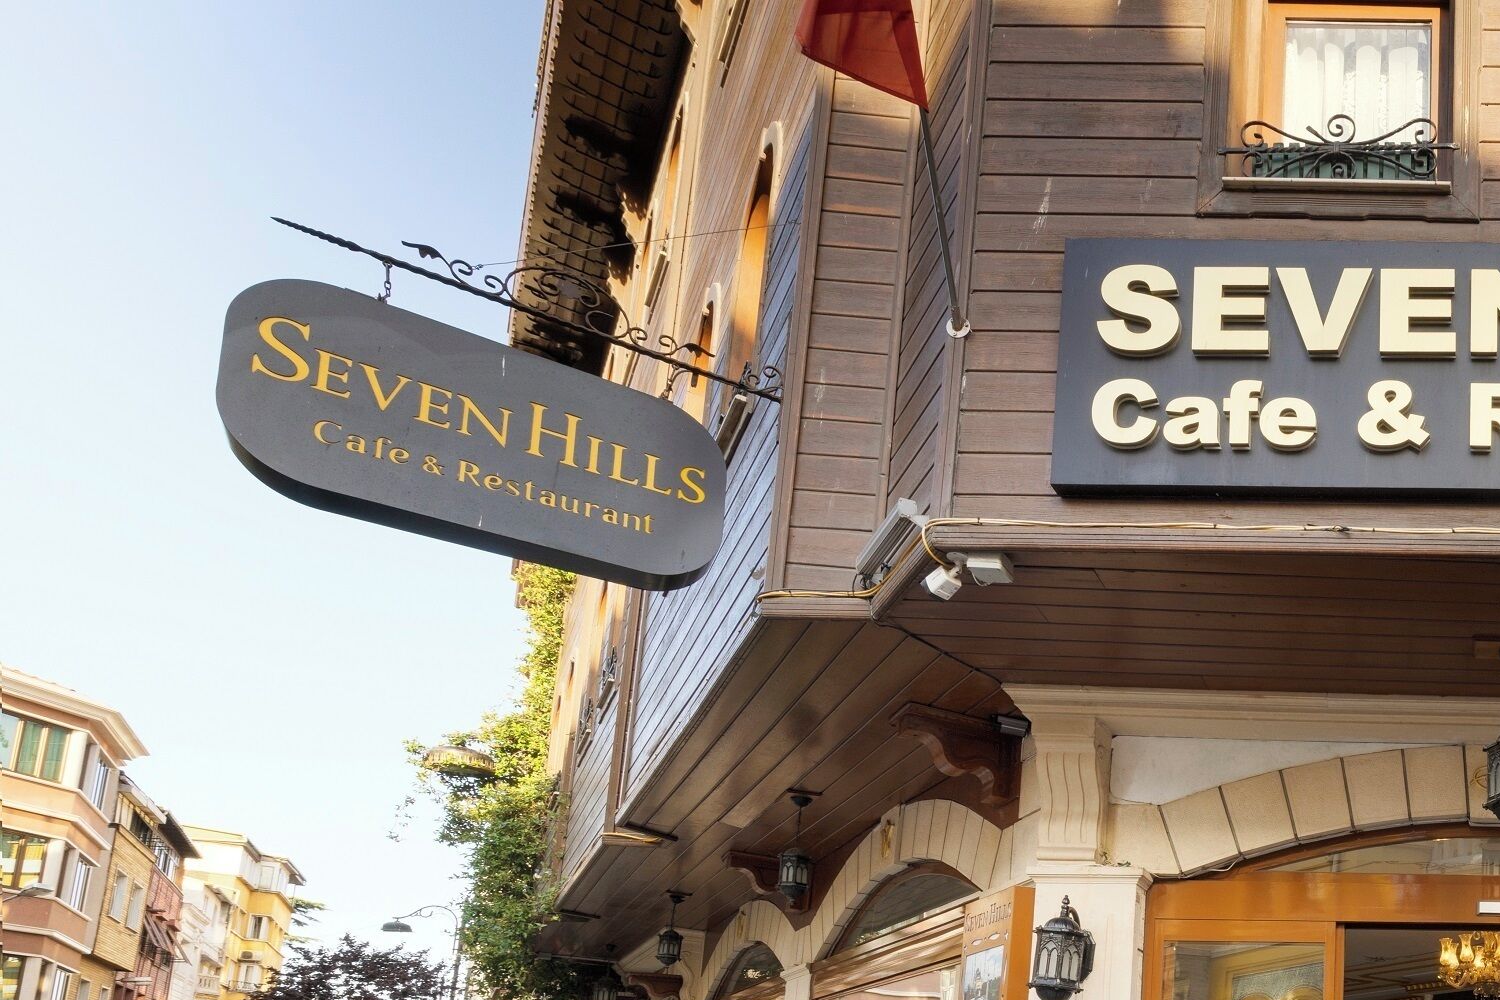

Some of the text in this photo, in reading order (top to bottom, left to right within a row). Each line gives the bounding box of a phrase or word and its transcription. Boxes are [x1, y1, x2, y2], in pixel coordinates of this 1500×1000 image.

[1091, 378, 1318, 452] Cafe
[1357, 379, 1431, 453] &
[313, 418, 656, 535] Cafe & Restaurant
